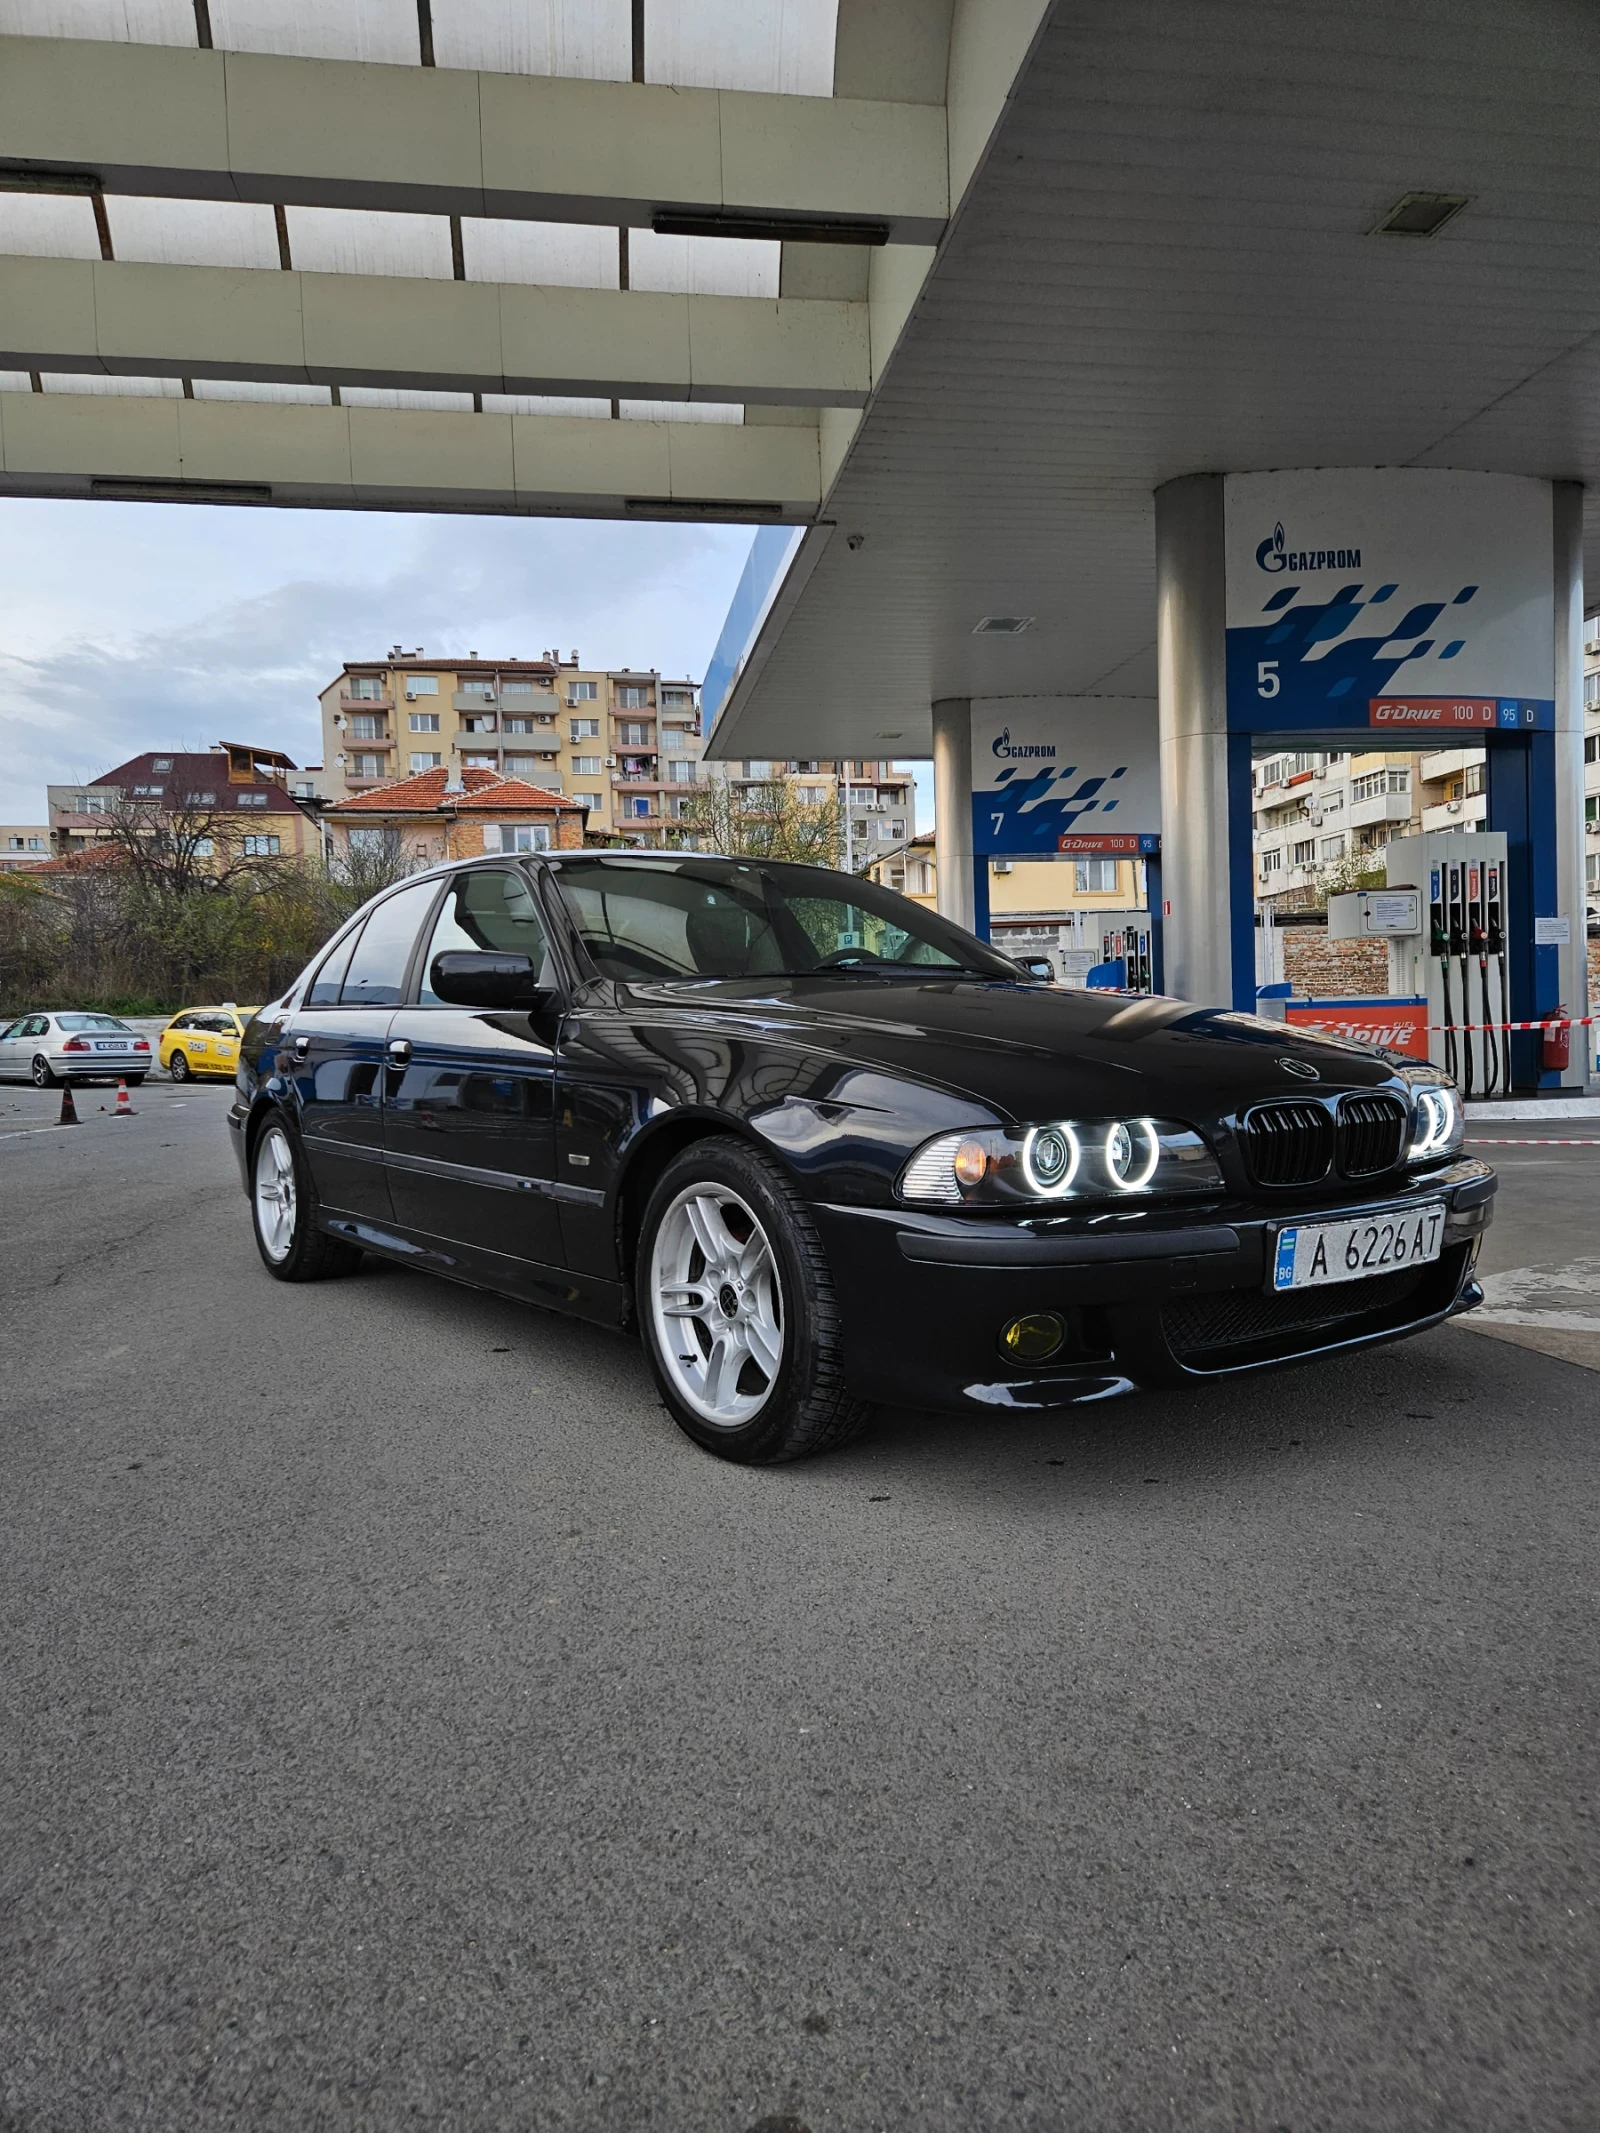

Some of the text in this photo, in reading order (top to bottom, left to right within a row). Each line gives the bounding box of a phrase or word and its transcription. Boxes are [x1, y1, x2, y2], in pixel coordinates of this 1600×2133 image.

[1288, 549, 1362, 571] GAZPROM
[1257, 661, 1280, 698] 5
[1452, 706, 1474, 720] 100
[1482, 707, 1491, 720] D
[1503, 708, 1516, 722] 95
[1526, 710, 1534, 723] D
[1011, 745, 1056, 758] GAZPROM
[990, 813, 1004, 835] 7
[1110, 839, 1124, 848] 100
[1129, 839, 1136, 848] D
[1143, 839, 1152, 848] 95
[1393, 1021, 1415, 1029] FUEL
[1310, 1213, 1441, 1278] A 6226 AT
[1279, 1268, 1292, 1280] BG
